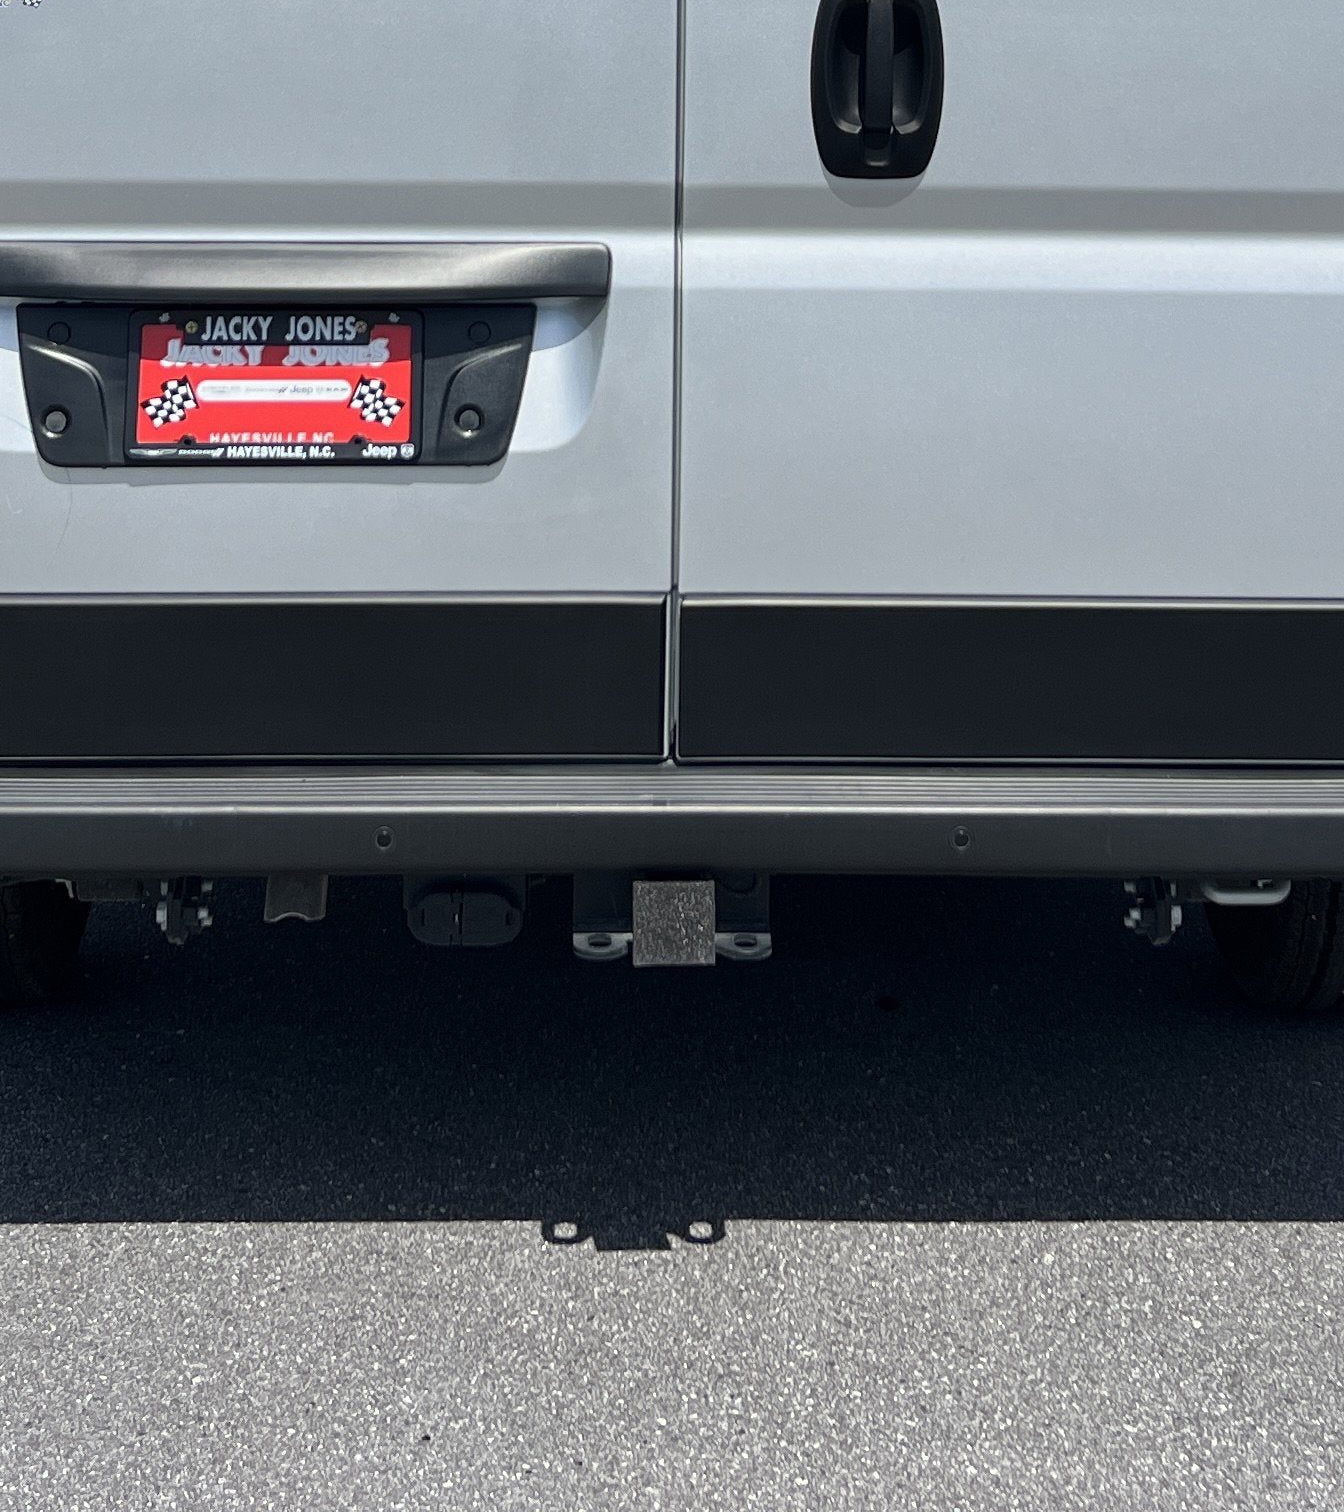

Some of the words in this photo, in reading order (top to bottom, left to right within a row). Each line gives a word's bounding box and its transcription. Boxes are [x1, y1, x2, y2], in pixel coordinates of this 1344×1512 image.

[202, 315, 273, 342] JACKY
[285, 315, 356, 342] JONES
[160, 338, 265, 367] JACKY
[282, 338, 390, 367] JONES
[226, 445, 307, 459] HAYESVILLE,
[309, 446, 335, 458] N.C.
[362, 443, 397, 459] Jeep
